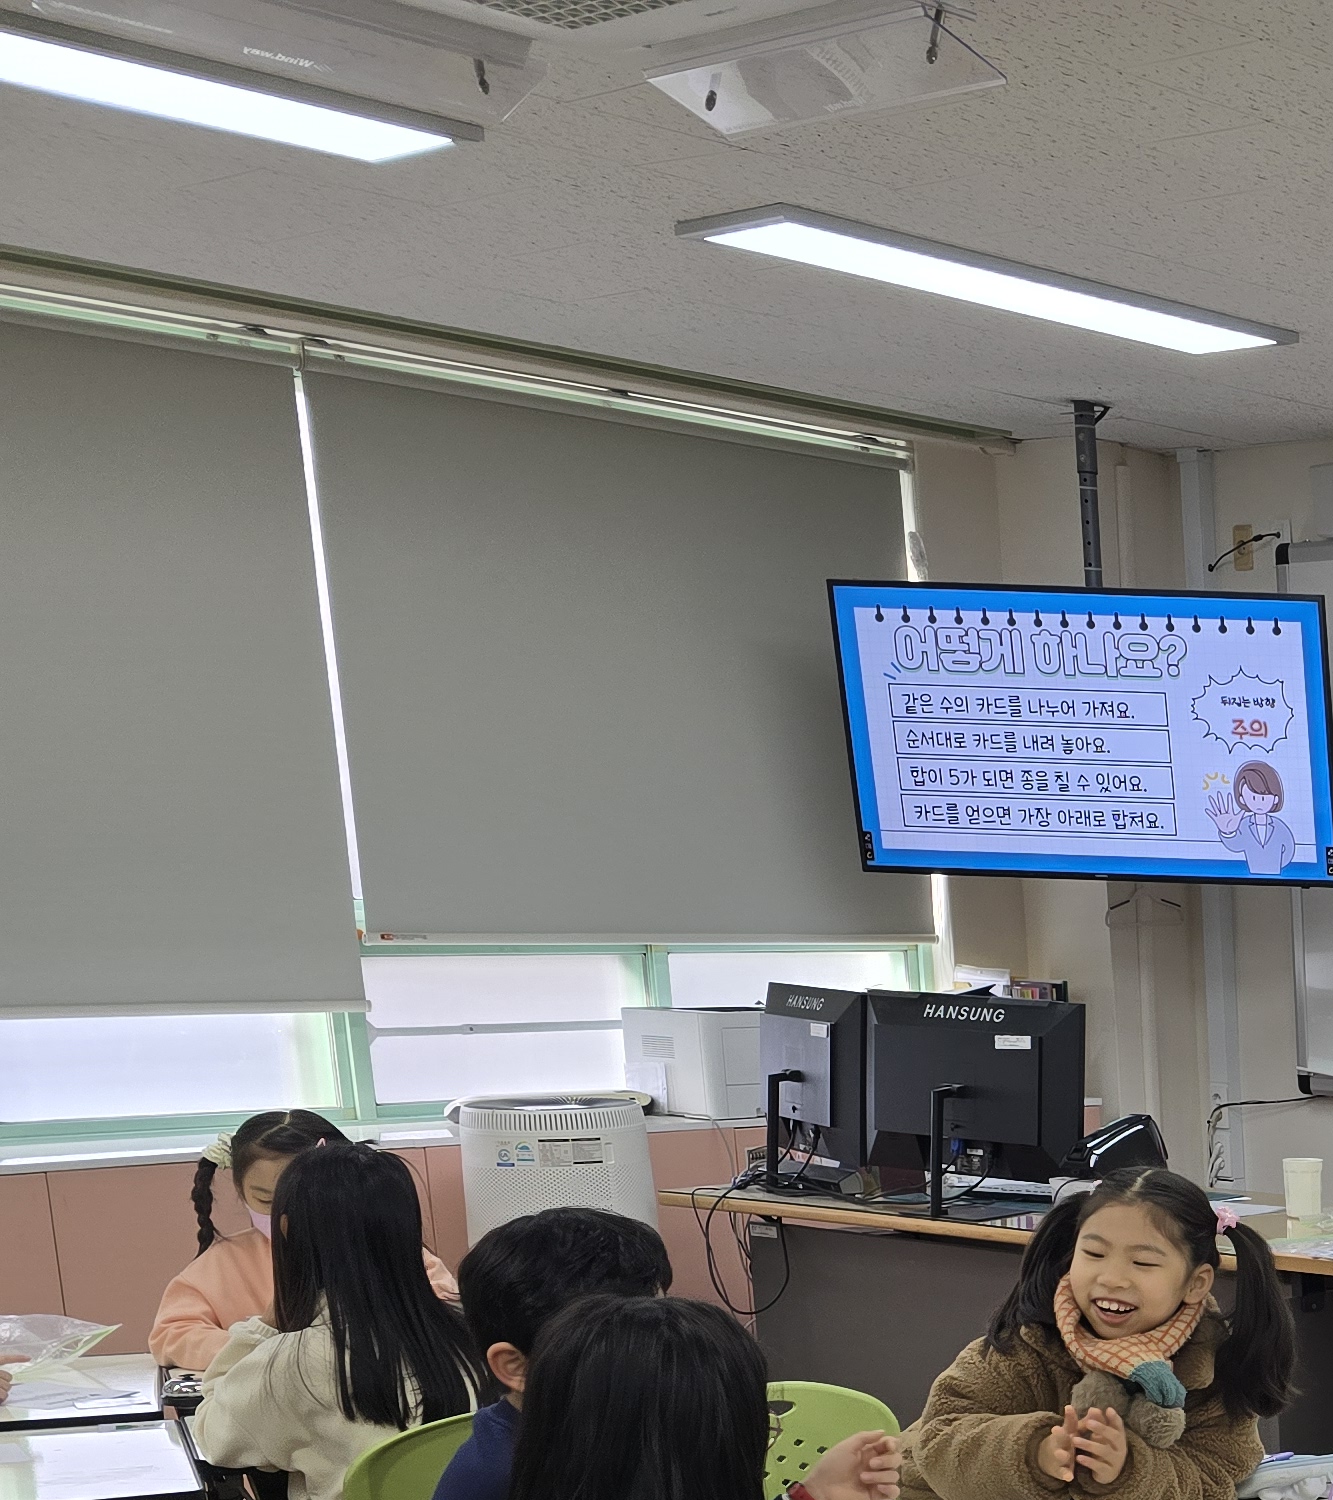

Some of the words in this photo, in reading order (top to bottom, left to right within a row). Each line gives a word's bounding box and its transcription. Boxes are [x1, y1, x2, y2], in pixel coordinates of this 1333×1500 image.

[894, 625, 1025, 677] 어떻게
[1030, 629, 1187, 680] 하나요?
[901, 692, 934, 714] 같은
[939, 696, 969, 714] 수의
[976, 695, 1022, 717] 카드를
[1028, 698, 1075, 717] 나누어
[1082, 700, 1135, 719] 가져요.
[1221, 696, 1251, 708] 뒤집는
[1253, 697, 1275, 708] 방향
[906, 729, 967, 749] 순서대로
[972, 731, 1018, 752] 카드를
[1023, 735, 1054, 752] 내려
[1061, 734, 1111, 754] 놓아요.
[1231, 719, 1268, 739] 주의
[909, 766, 943, 786] 합이
[949, 769, 977, 786] 5가
[983, 769, 1014, 790] 되면
[1020, 770, 1049, 792] 종을
[1054, 771, 1070, 792] 칠
[1077, 774, 1090, 791] 수
[1096, 772, 1147, 793] 있어요.
[913, 803, 959, 825] 카드를
[966, 805, 1011, 825] 얻으면
[1018, 808, 1052, 828] 가장
[1058, 809, 1106, 828] 아래로
[1112, 810, 1164, 830] 합쳐요.
[786, 994, 825, 1011] HANSUNG
[923, 1004, 1005, 1023] HANSUNG
